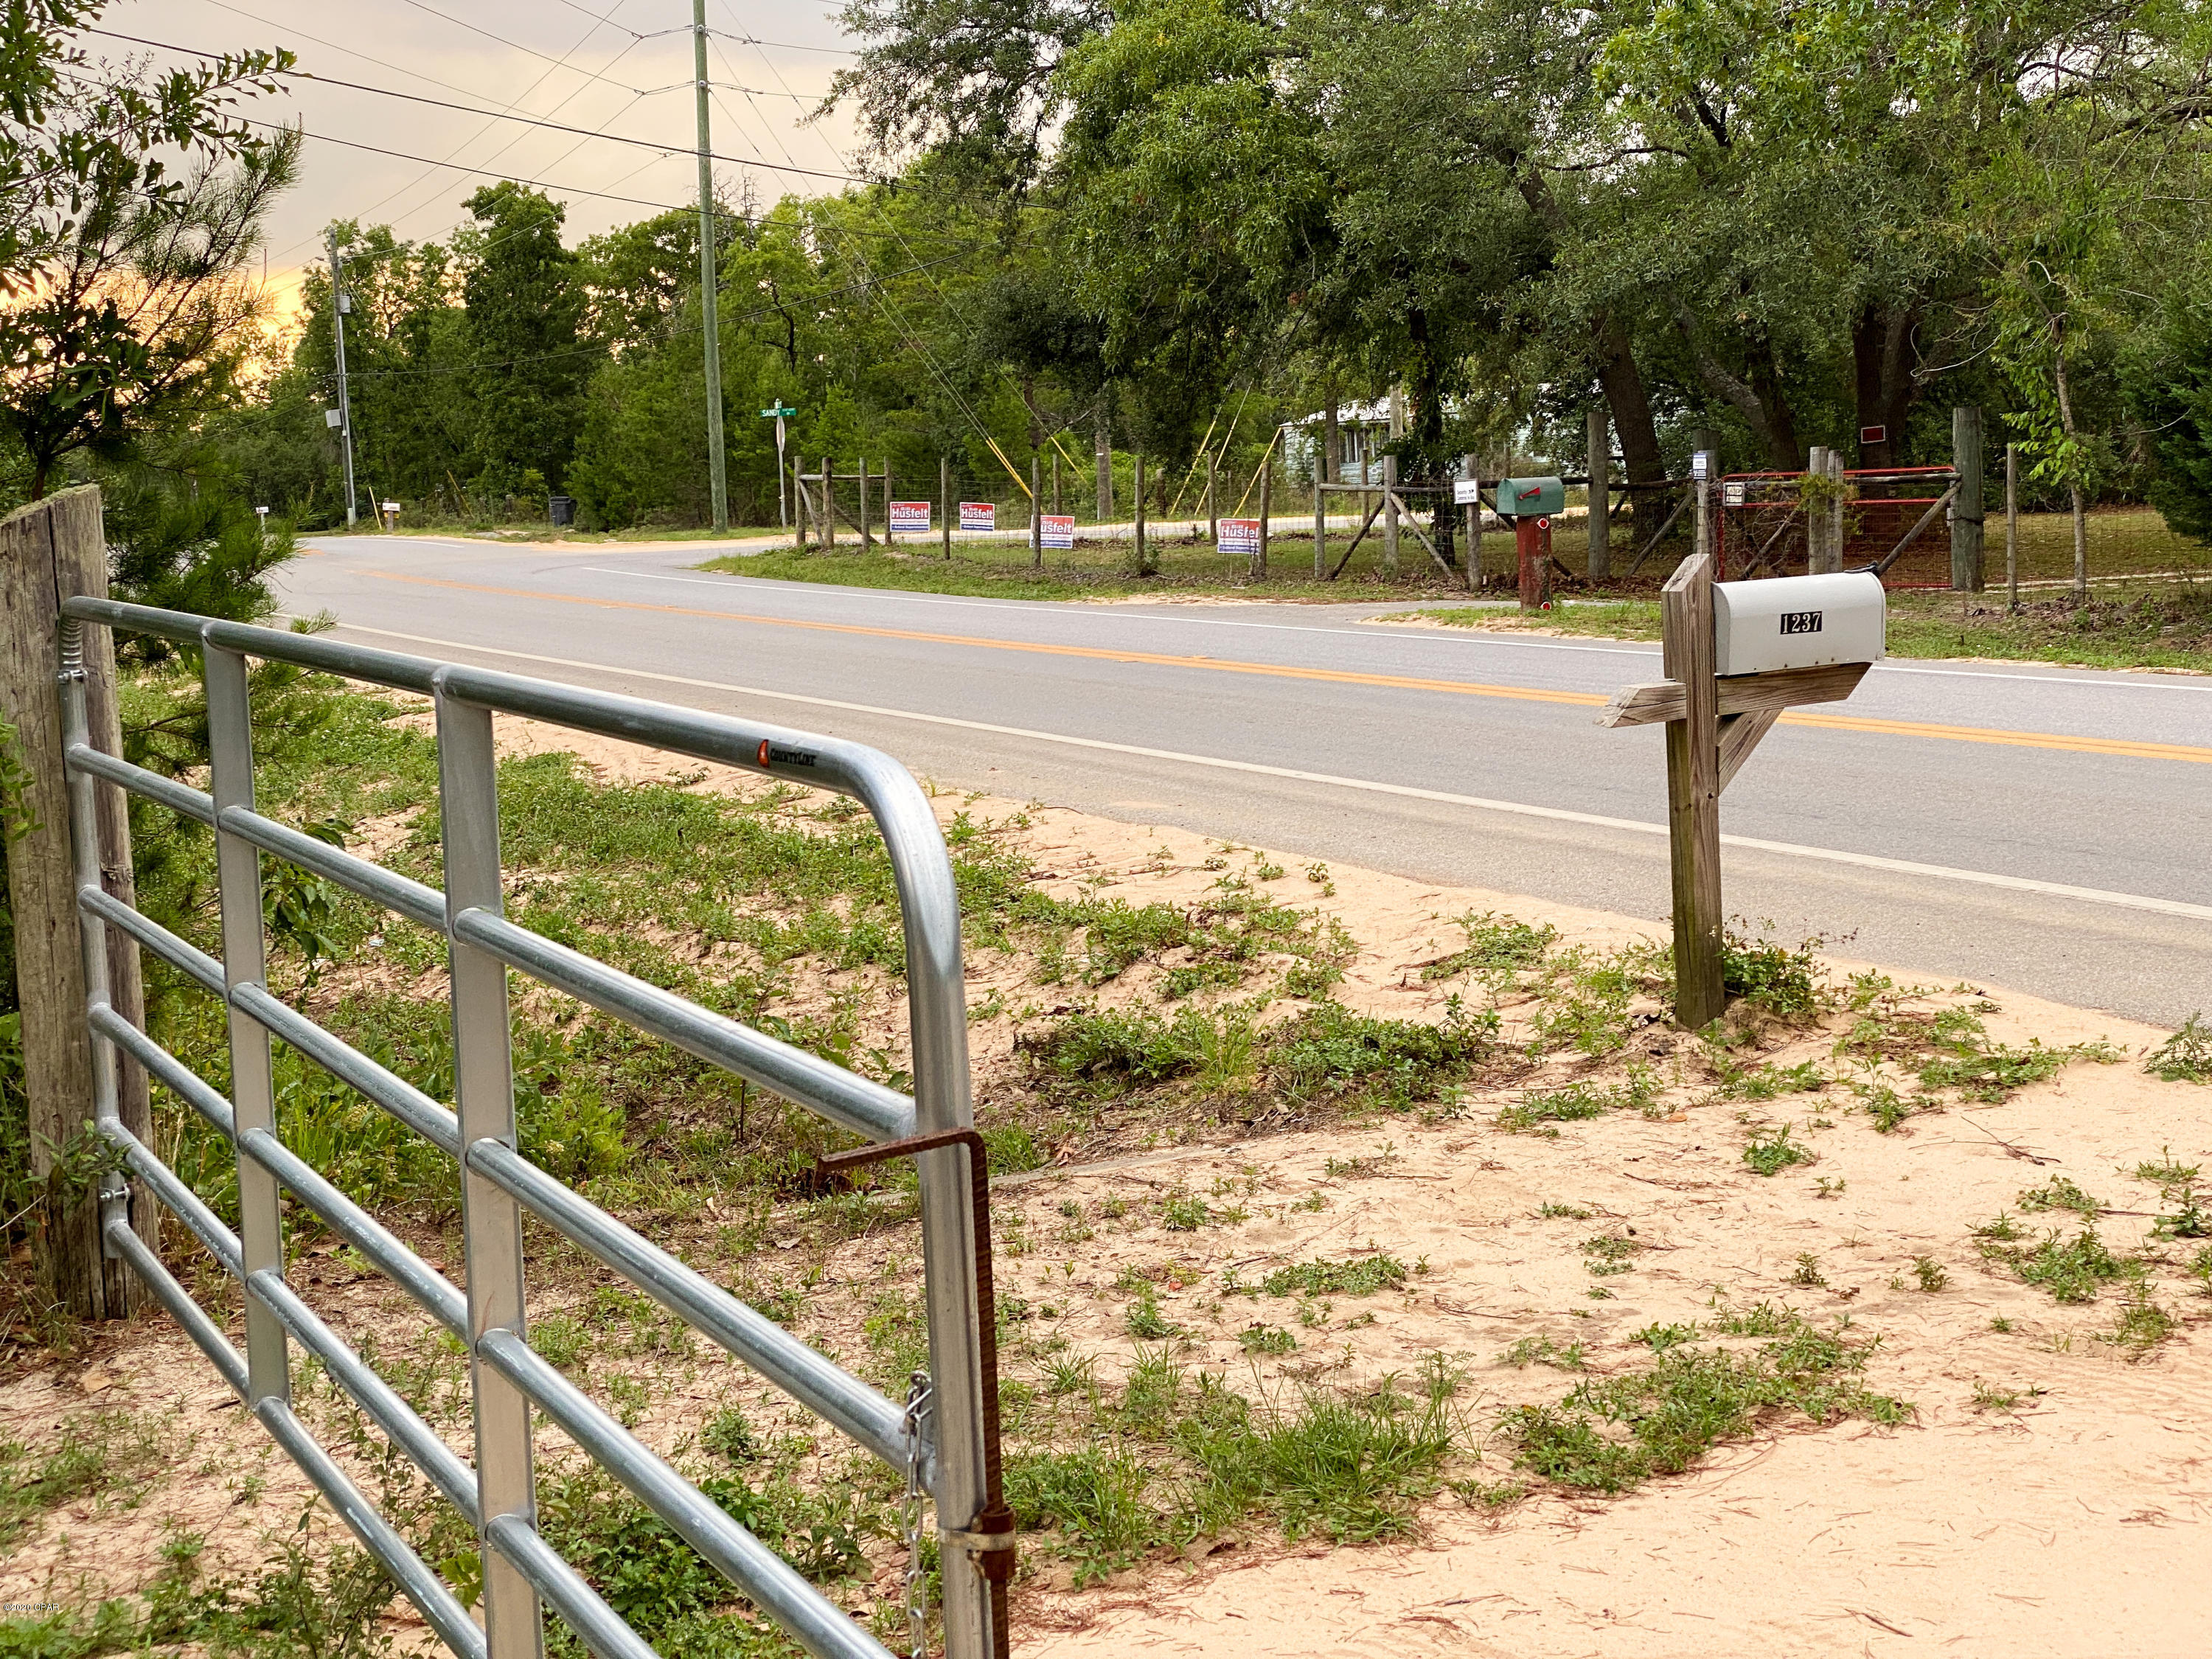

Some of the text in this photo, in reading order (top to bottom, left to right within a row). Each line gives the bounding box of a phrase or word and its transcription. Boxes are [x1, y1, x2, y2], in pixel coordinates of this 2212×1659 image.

[891, 507, 928, 518] Husfelt
[961, 508, 993, 519] Husfelt
[1040, 522, 1071, 533] usfelt
[1220, 526, 1259, 538] Husfel
[1782, 612, 1821, 634] 1237
